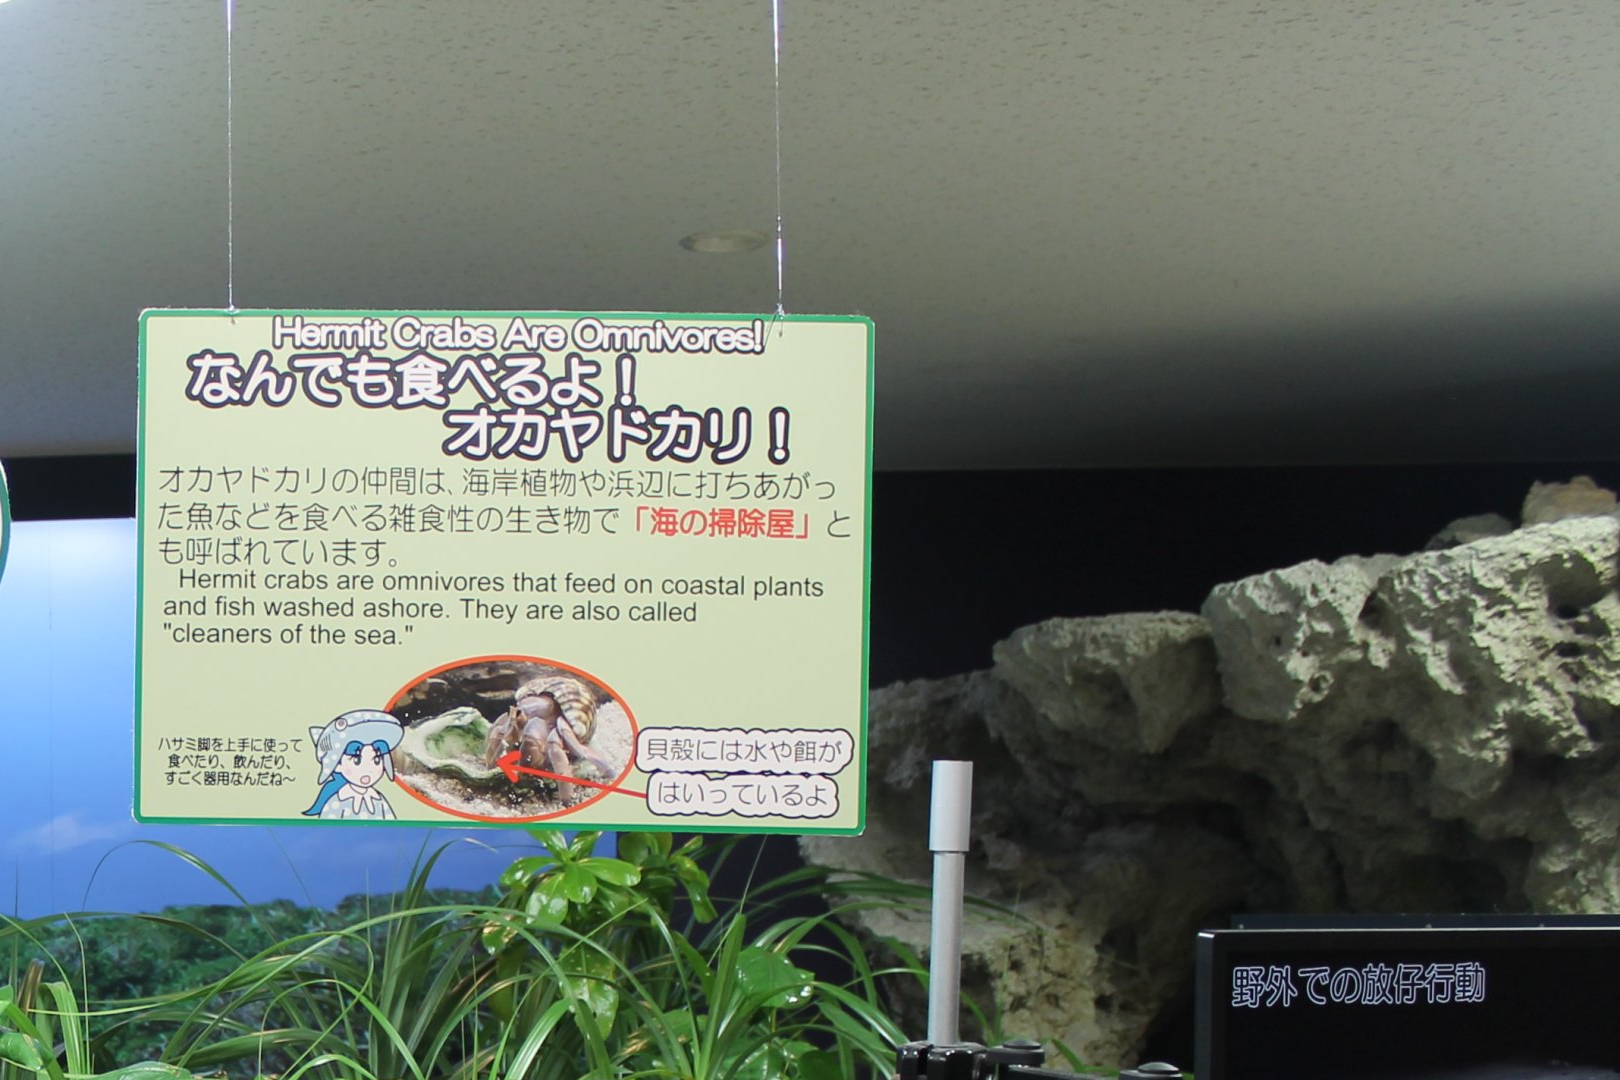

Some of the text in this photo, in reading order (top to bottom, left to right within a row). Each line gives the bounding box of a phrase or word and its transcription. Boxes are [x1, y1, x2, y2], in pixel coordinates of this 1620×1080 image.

[272, 316, 766, 355] Hermit Crabs Are Omnivores!
[159, 536, 397, 568] も呼ばれています。
[179, 568, 824, 600] Hermit crabs are omnivores that feed on coastal plants
[163, 596, 697, 624] and fish washed ashore. They are also called
[163, 622, 413, 645] "cleaners of the sea."
[647, 738, 842, 763] 貝殻には水や餌が
[658, 781, 827, 806] はいっているよ
[1231, 962, 1485, 1008] 野外での放仔行動
